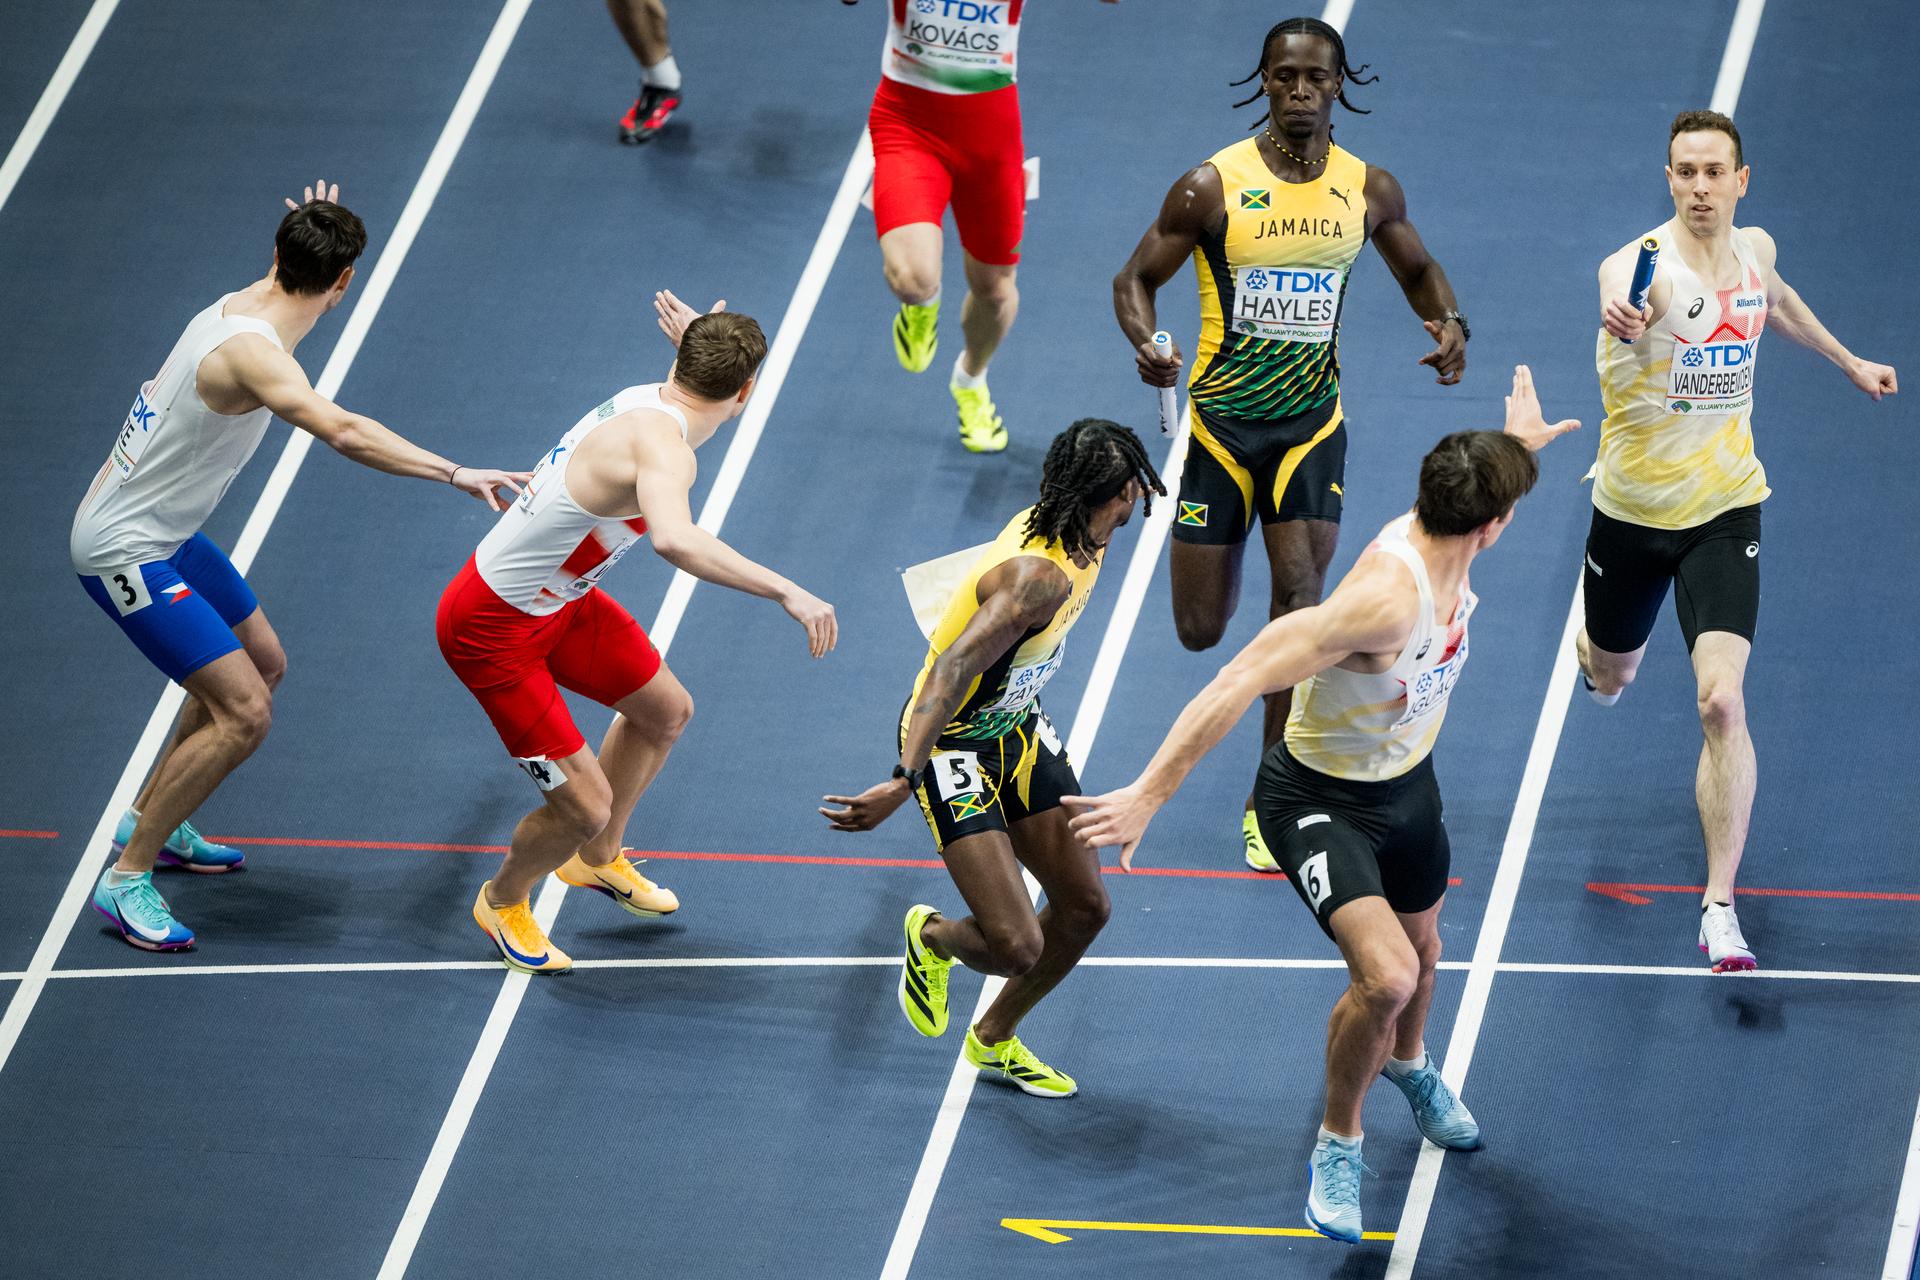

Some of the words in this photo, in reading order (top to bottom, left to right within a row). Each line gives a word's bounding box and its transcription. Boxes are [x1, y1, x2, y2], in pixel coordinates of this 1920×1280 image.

[939, 0, 1002, 25] TDK
[909, 20, 999, 51] KOVÁCS
[1254, 217, 1343, 240] JAMAICA
[1269, 271, 1335, 293] TDK
[1241, 294, 1332, 322] HAYLES
[1736, 298, 1756, 309] Allianz
[1262, 327, 1292, 336] KUJAWY
[1292, 329, 1323, 338] POMORZE
[1704, 340, 1756, 367] TDK
[132, 395, 156, 433] DK
[1696, 403, 1725, 411] KUJAWY
[113, 574, 137, 607] 3
[529, 760, 552, 785] 4
[948, 758, 972, 790] 5
[1308, 864, 1320, 900] 6
